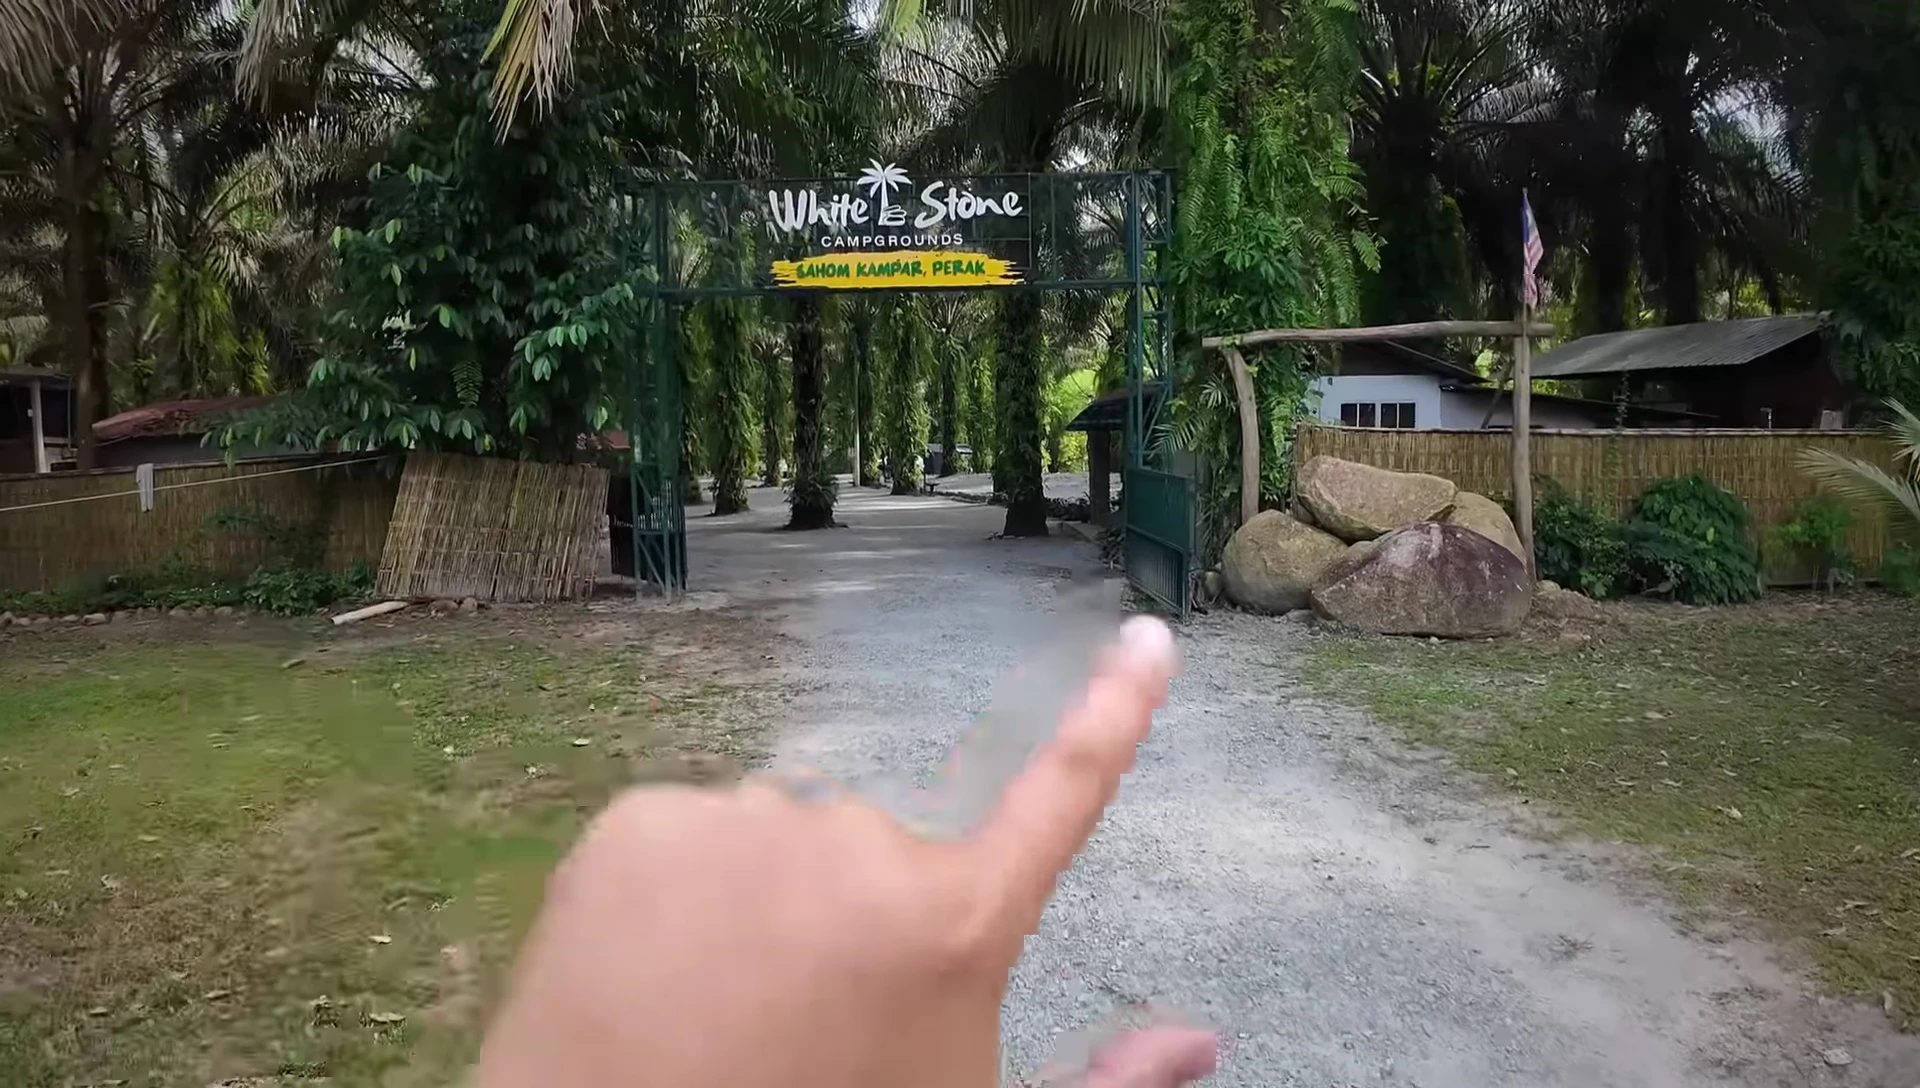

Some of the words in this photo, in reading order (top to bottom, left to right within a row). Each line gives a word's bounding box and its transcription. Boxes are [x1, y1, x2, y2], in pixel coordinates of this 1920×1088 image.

[769, 189, 869, 232] White
[914, 181, 1023, 229] Stone
[821, 233, 963, 247] CAMPGROUNDS
[796, 262, 850, 279] SAHOM
[856, 260, 927, 277] KAMPAR,
[932, 259, 985, 276] PERAK
